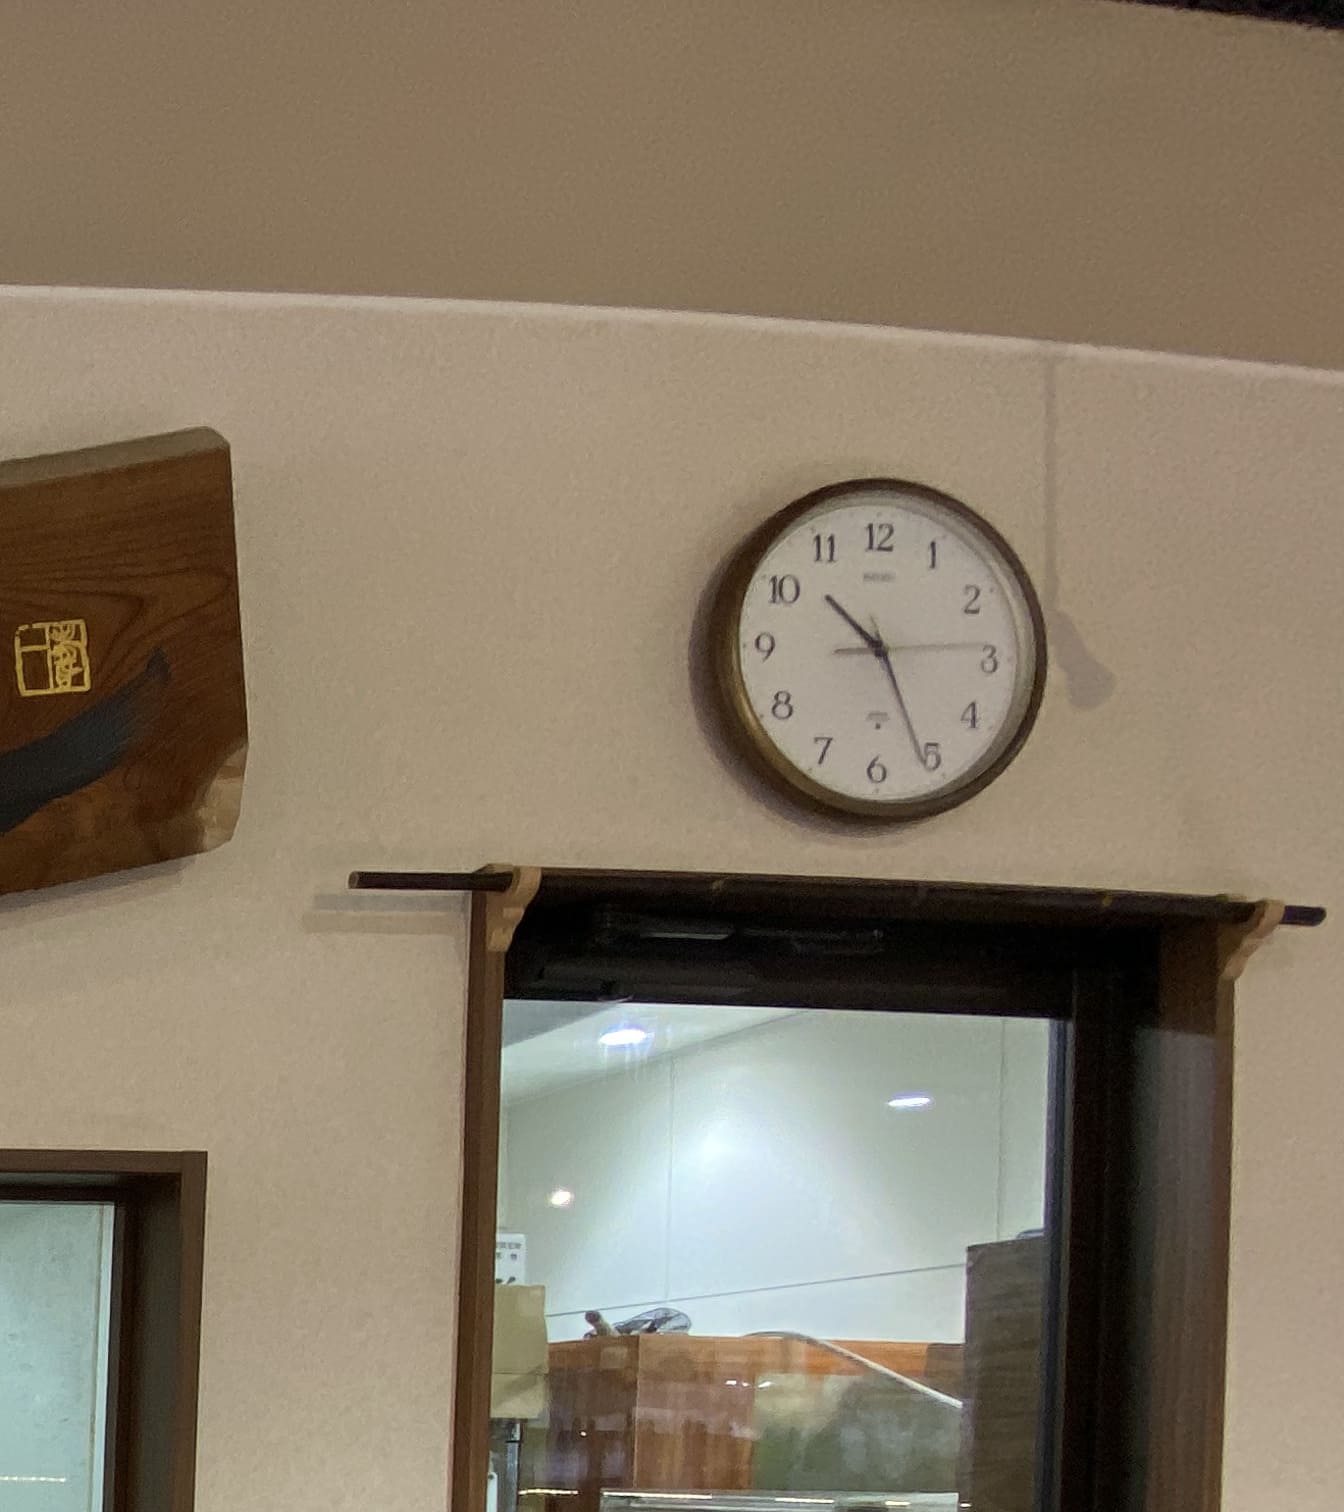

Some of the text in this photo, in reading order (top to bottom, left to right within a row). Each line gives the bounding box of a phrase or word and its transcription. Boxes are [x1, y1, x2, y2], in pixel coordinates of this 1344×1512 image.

[814, 533, 837, 562] 11
[865, 523, 894, 551] 12
[929, 541, 937, 569] 1
[768, 574, 800, 604] 10
[964, 585, 981, 614] 2
[755, 632, 775, 662] 9
[981, 645, 998, 674] 3
[771, 691, 793, 720] 8
[961, 701, 979, 729] 4
[814, 737, 833, 764] 7
[923, 743, 941, 771] 5
[867, 756, 887, 783] 6
